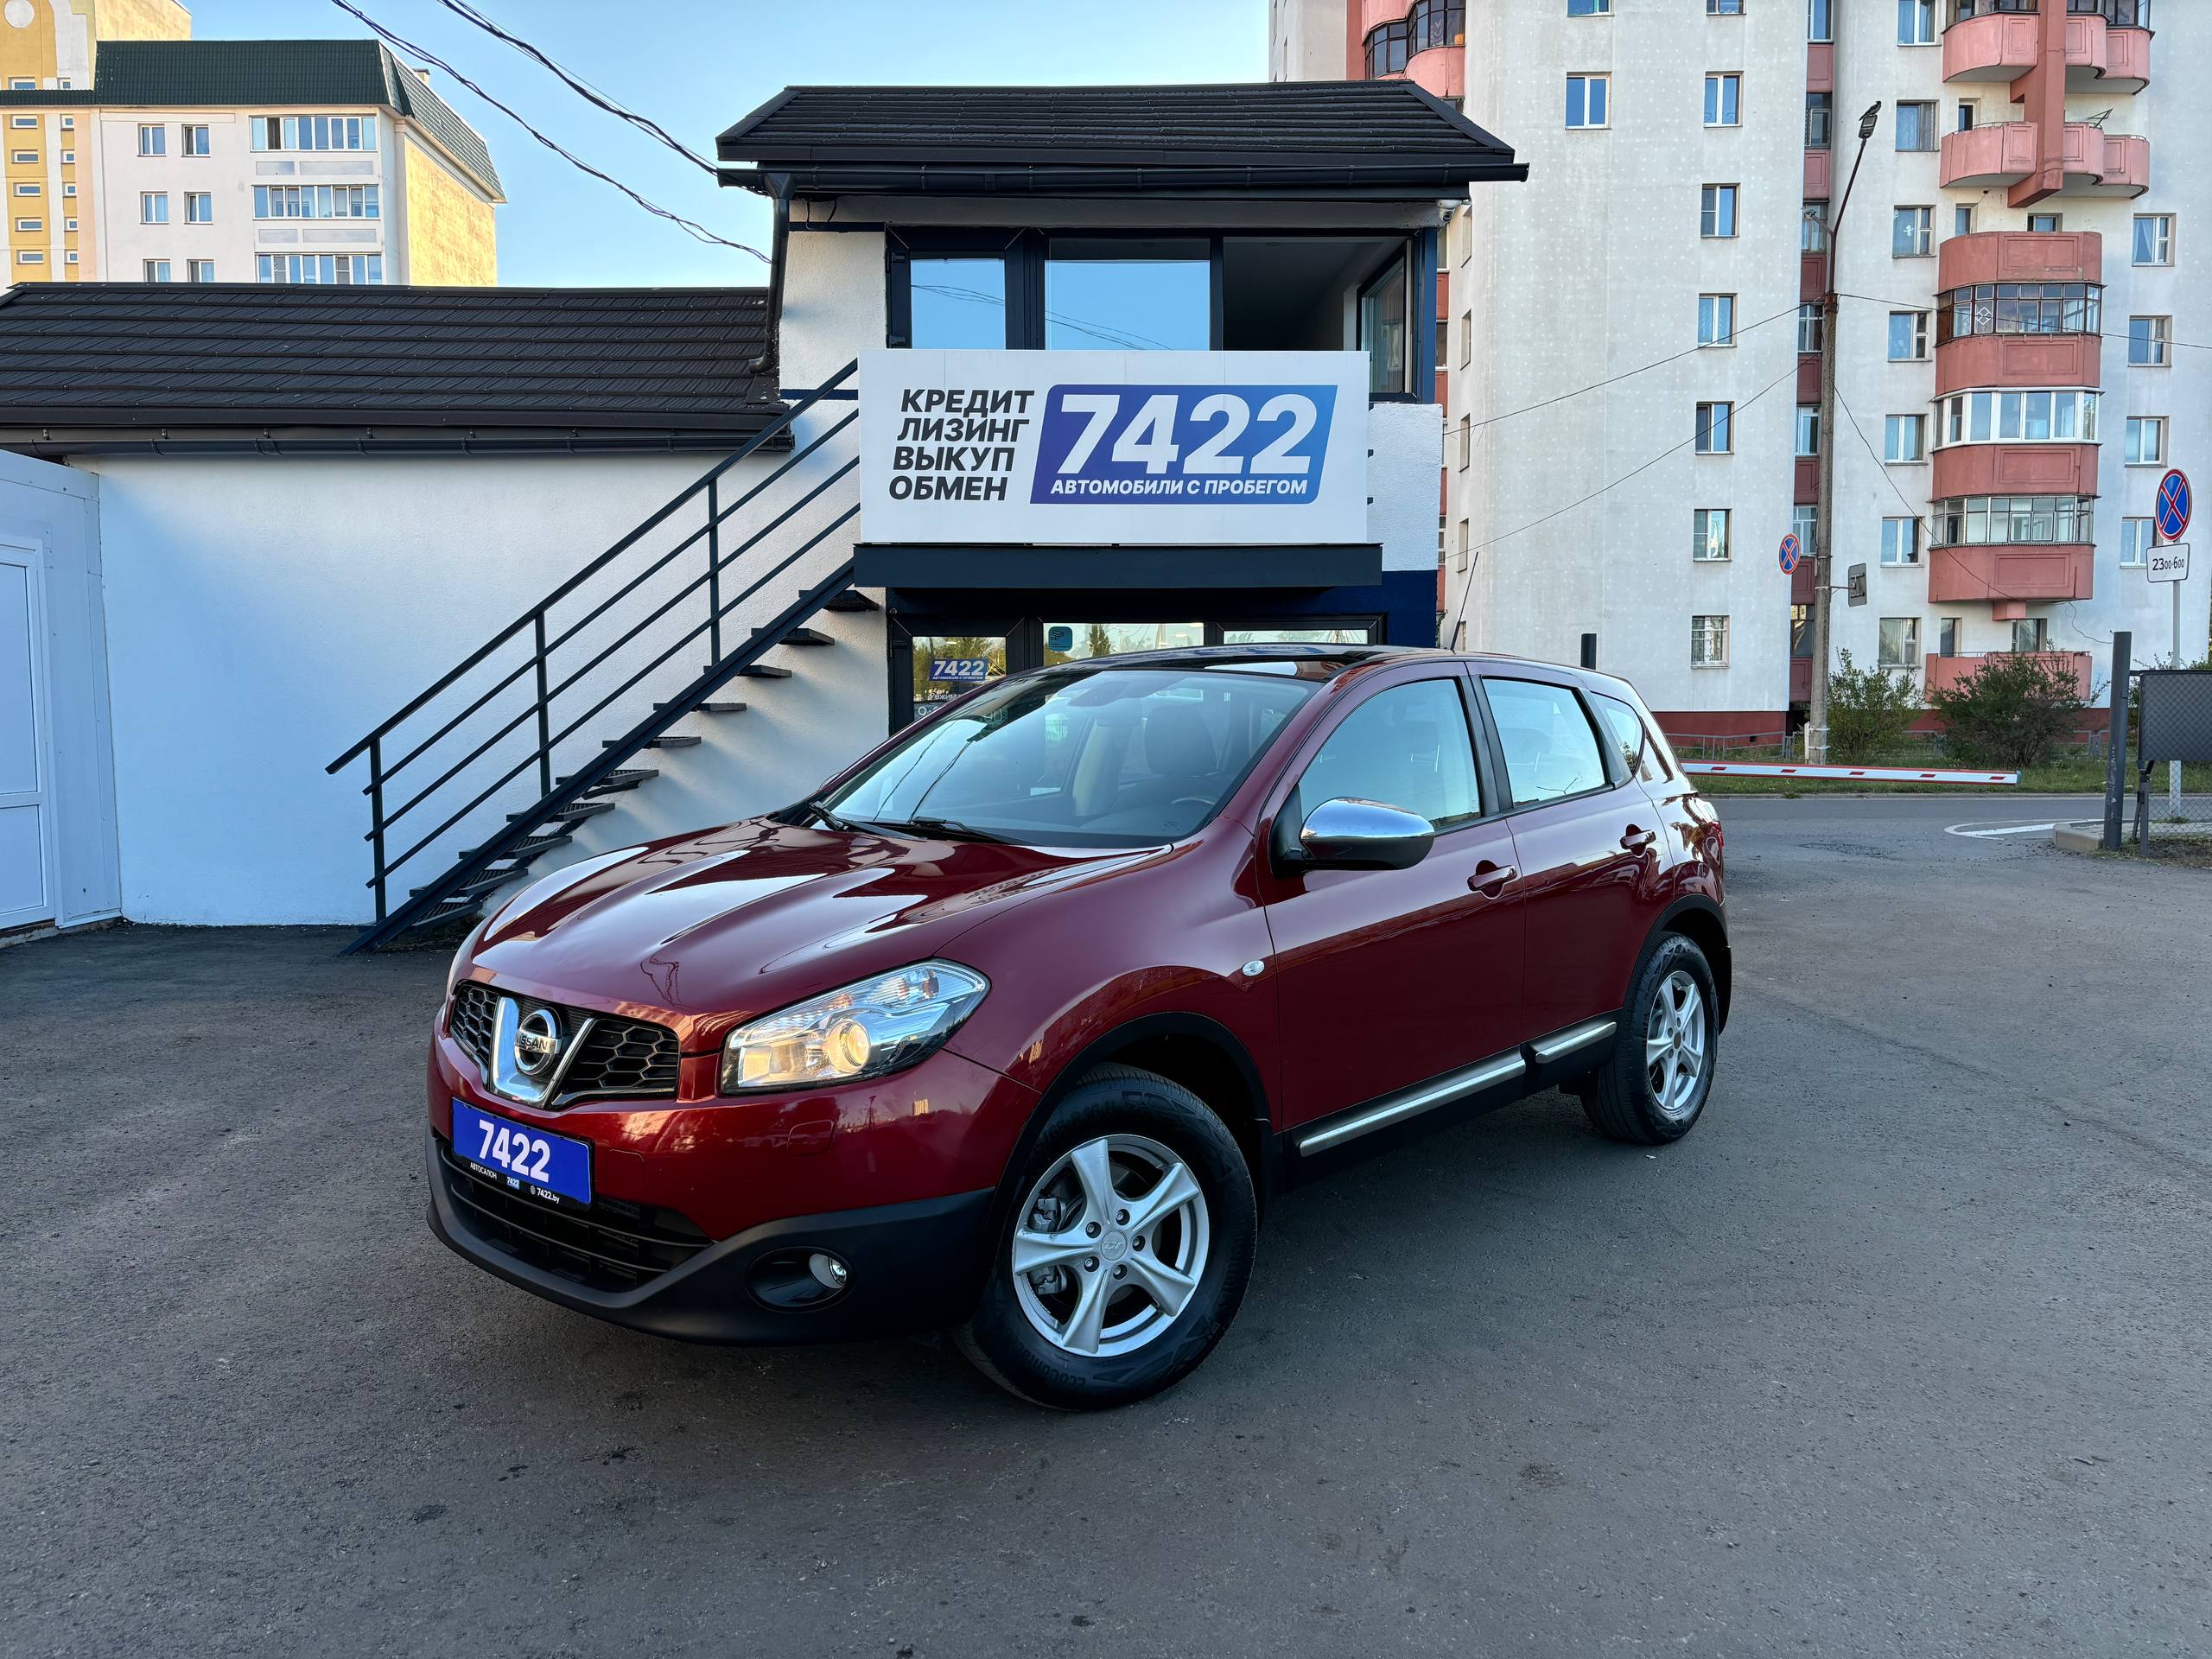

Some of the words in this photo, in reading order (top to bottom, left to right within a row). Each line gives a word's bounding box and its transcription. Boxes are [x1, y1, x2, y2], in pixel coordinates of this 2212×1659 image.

[900, 389, 1034, 414] КРЕДИТ
[897, 418, 1030, 442] ЛИЗИНГ
[1058, 393, 1318, 474] 7422
[893, 447, 1014, 471] ВЫКУП
[888, 475, 1007, 501] ОБМЕН
[1050, 480, 1185, 495] АВТОМОБИЛИ
[1187, 480, 1200, 495] С
[1204, 480, 1307, 495] ПРОБЕГОМ
[933, 660, 984, 676] 7422
[479, 1119, 550, 1183] 7422
[470, 1162, 498, 1179] АВТОСАЛОН
[506, 1176, 518, 1187] 7422
[537, 1187, 560, 1204] 7422.by
